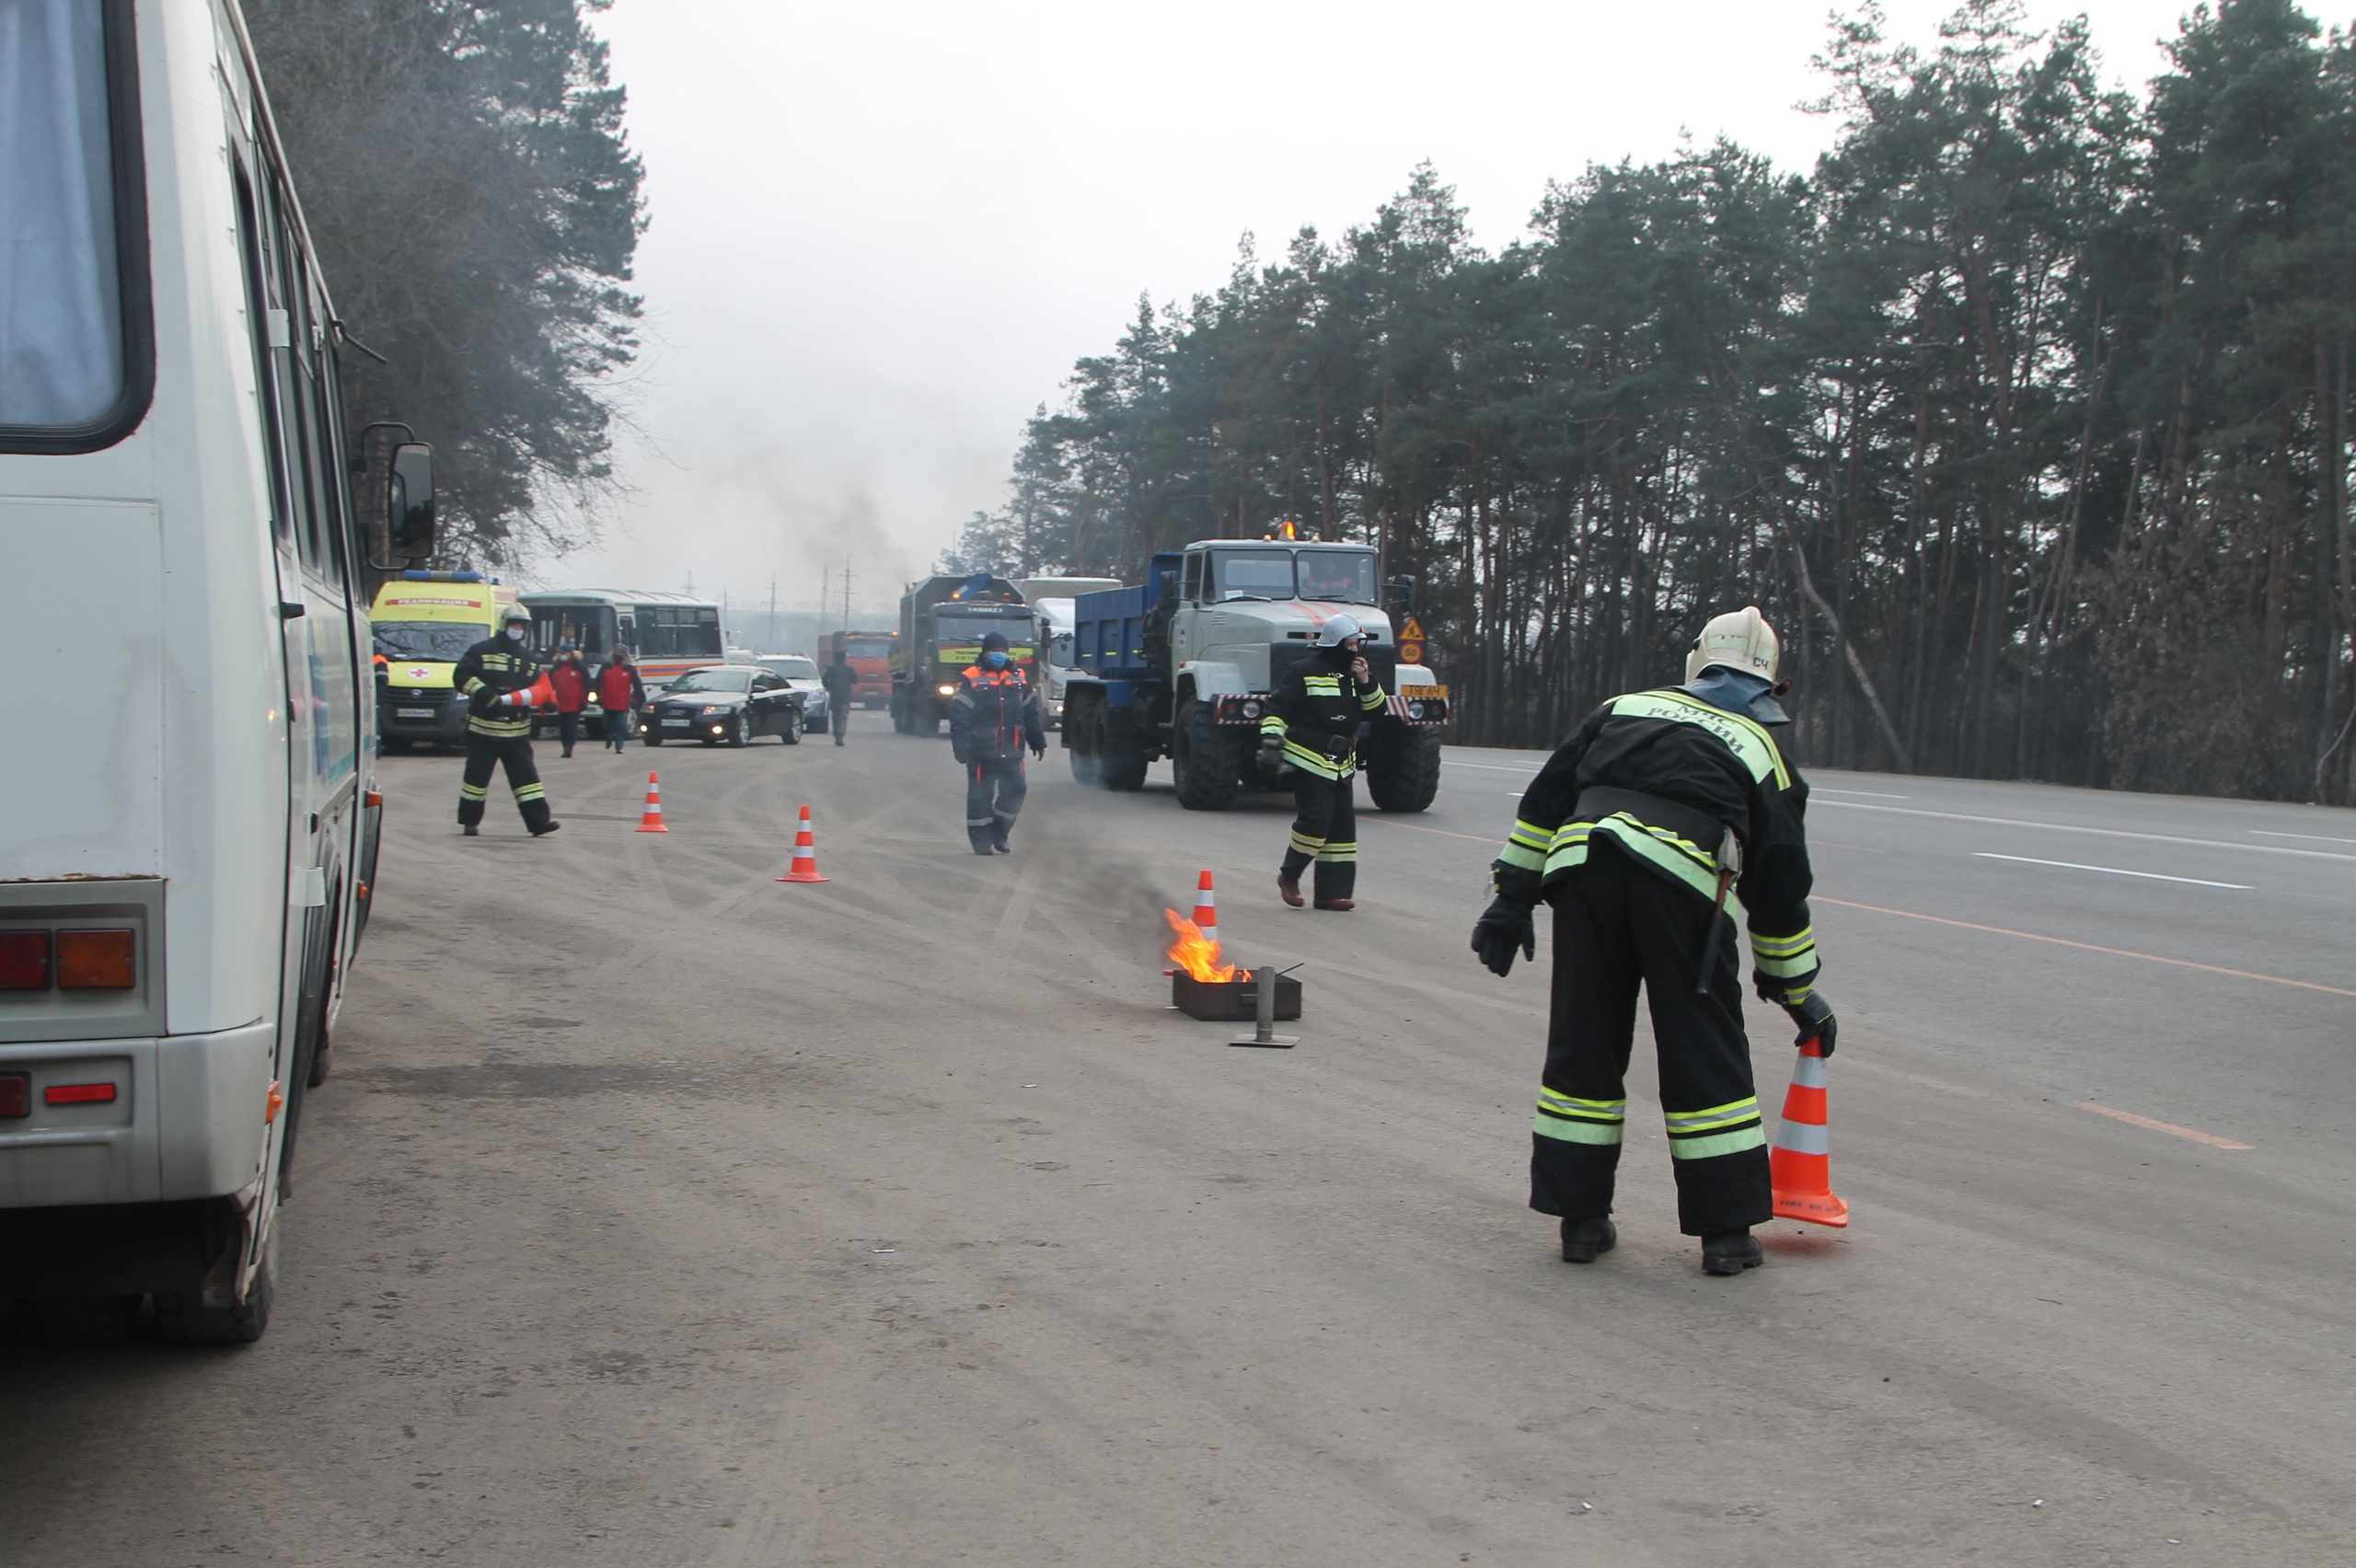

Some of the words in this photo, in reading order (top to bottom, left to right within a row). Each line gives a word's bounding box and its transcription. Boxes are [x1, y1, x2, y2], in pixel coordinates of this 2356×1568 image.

[1404, 648, 1417, 657] 50
[1408, 685, 1440, 697] ТЯГАЧ
[1678, 706, 1736, 728] МЧС
[1646, 708, 1745, 754] РОССИИ
